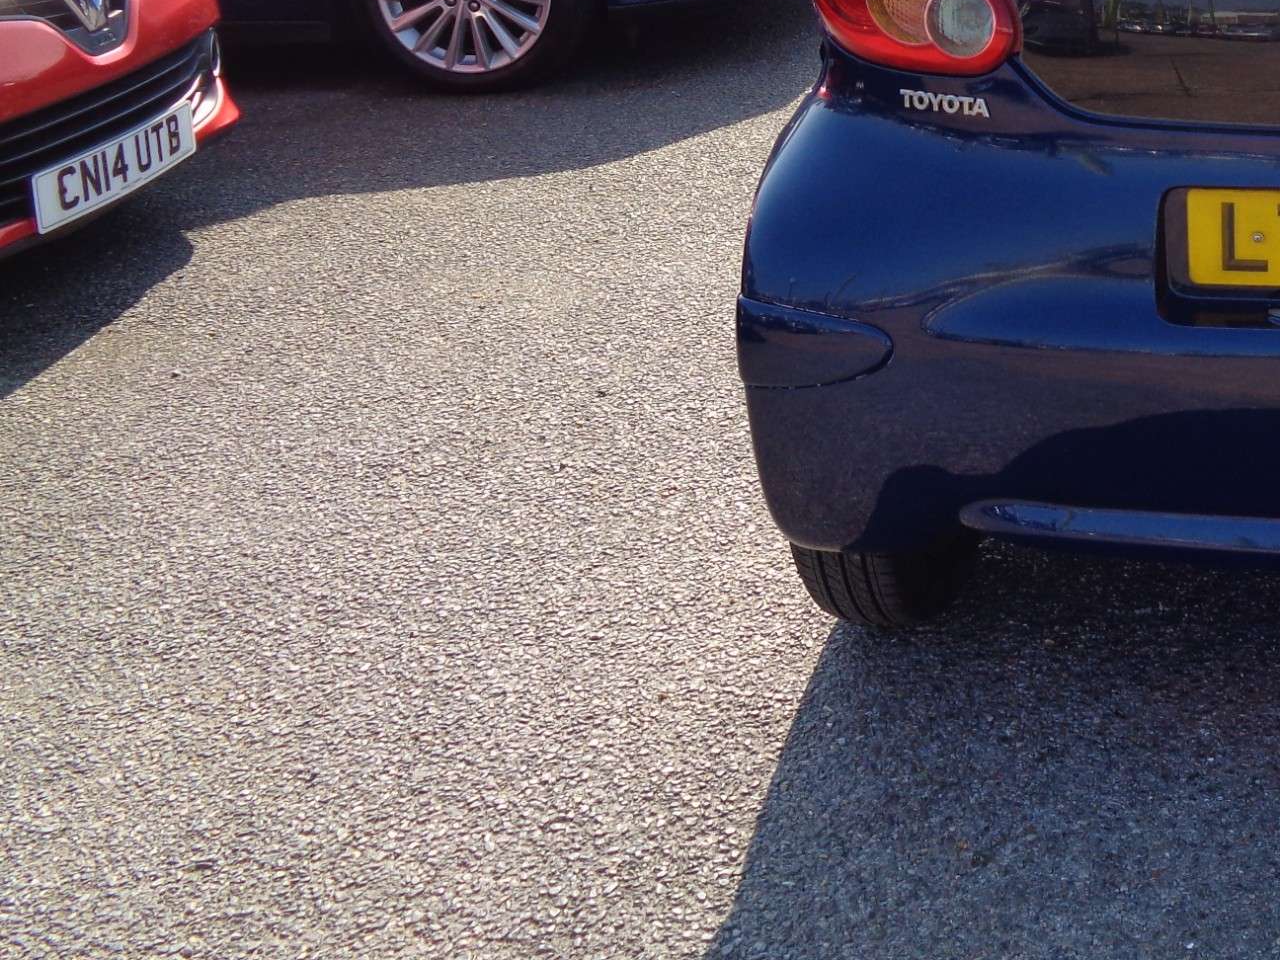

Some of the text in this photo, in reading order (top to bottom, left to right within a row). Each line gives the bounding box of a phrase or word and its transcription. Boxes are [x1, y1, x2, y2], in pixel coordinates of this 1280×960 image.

[899, 88, 990, 118] TOYOTA
[57, 114, 181, 211] CN14 UTB
